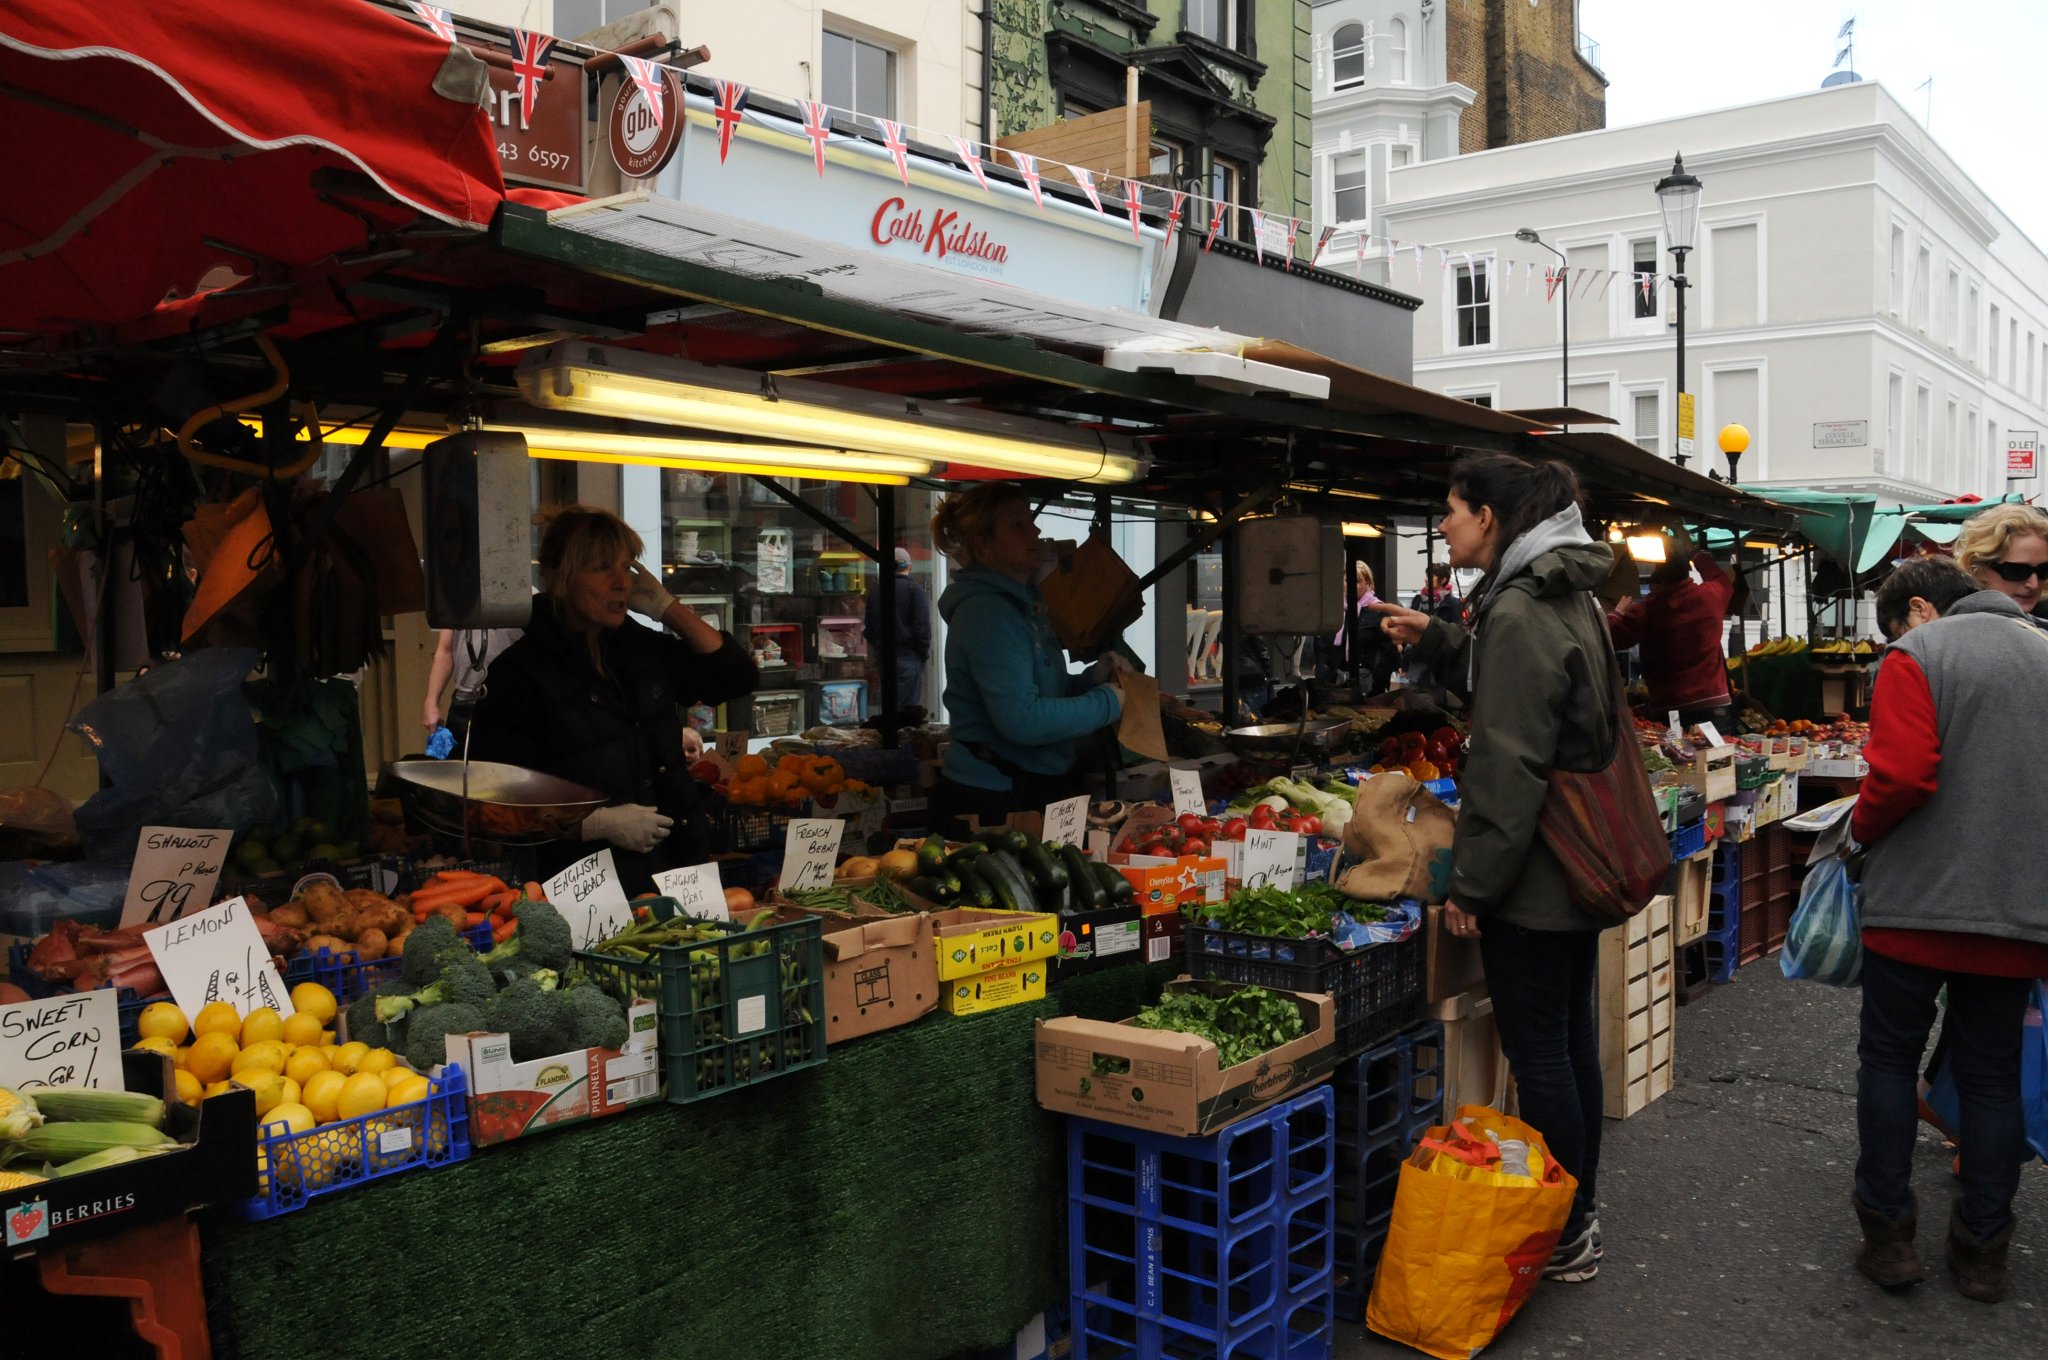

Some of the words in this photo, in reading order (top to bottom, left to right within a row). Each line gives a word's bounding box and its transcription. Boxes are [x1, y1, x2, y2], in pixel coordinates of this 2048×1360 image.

[529, 145, 570, 171] 6597
[628, 150, 658, 167] kitchen
[871, 196, 925, 245] Cath
[923, 207, 1009, 264] Kidston
[958, 258, 989, 273] LONDON
[2008, 440, 2017, 450] O
[2019, 440, 2036, 450] LET
[147, 833, 221, 850] SHALLOTS
[795, 822, 832, 840] FRENCH
[808, 840, 837, 855] BEANS
[1250, 837, 1277, 850] MINT
[553, 852, 599, 896] ENGLISH
[573, 868, 607, 903] BROADS
[664, 869, 699, 891] ENGLISH
[140, 880, 195, 923] 99
[682, 888, 704, 906] PEAS
[165, 902, 237, 952] LEMONS
[861, 968, 881, 980] CLASS
[2, 997, 92, 1038] SWEET
[25, 1027, 101, 1061] CORN
[540, 1073, 570, 1086] FLANDRIA
[592, 1054, 600, 1113] PRUNELLA
[1252, 1068, 1294, 1094] herbfresh
[51, 1193, 135, 1226] BERRIES
